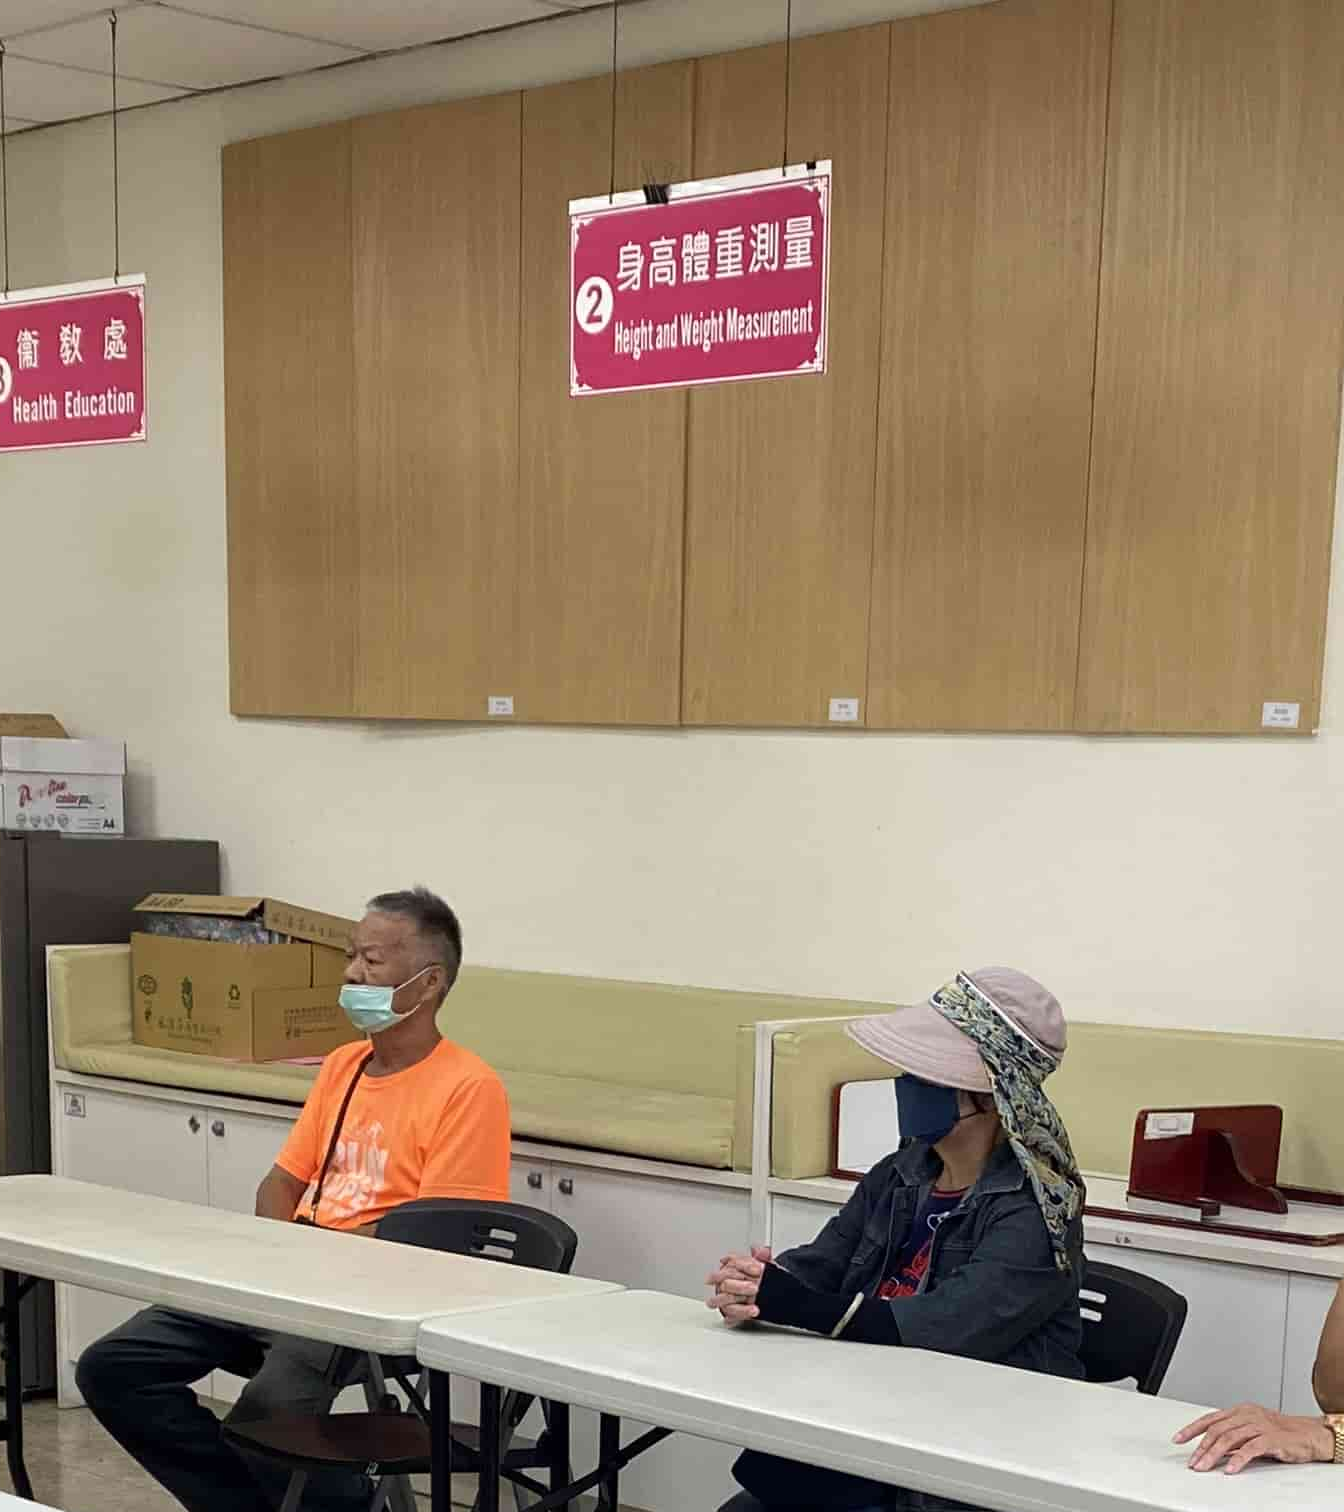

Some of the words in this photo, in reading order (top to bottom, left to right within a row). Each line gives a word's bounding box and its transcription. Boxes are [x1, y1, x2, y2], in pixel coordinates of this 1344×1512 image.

[615, 214, 815, 293] 身高體重測量
[613, 318, 654, 361] Height
[656, 314, 678, 350] and
[680, 310, 724, 353] Weight
[726, 299, 814, 342] Measurement
[13, 391, 57, 424] Health
[64, 386, 135, 419] Education
